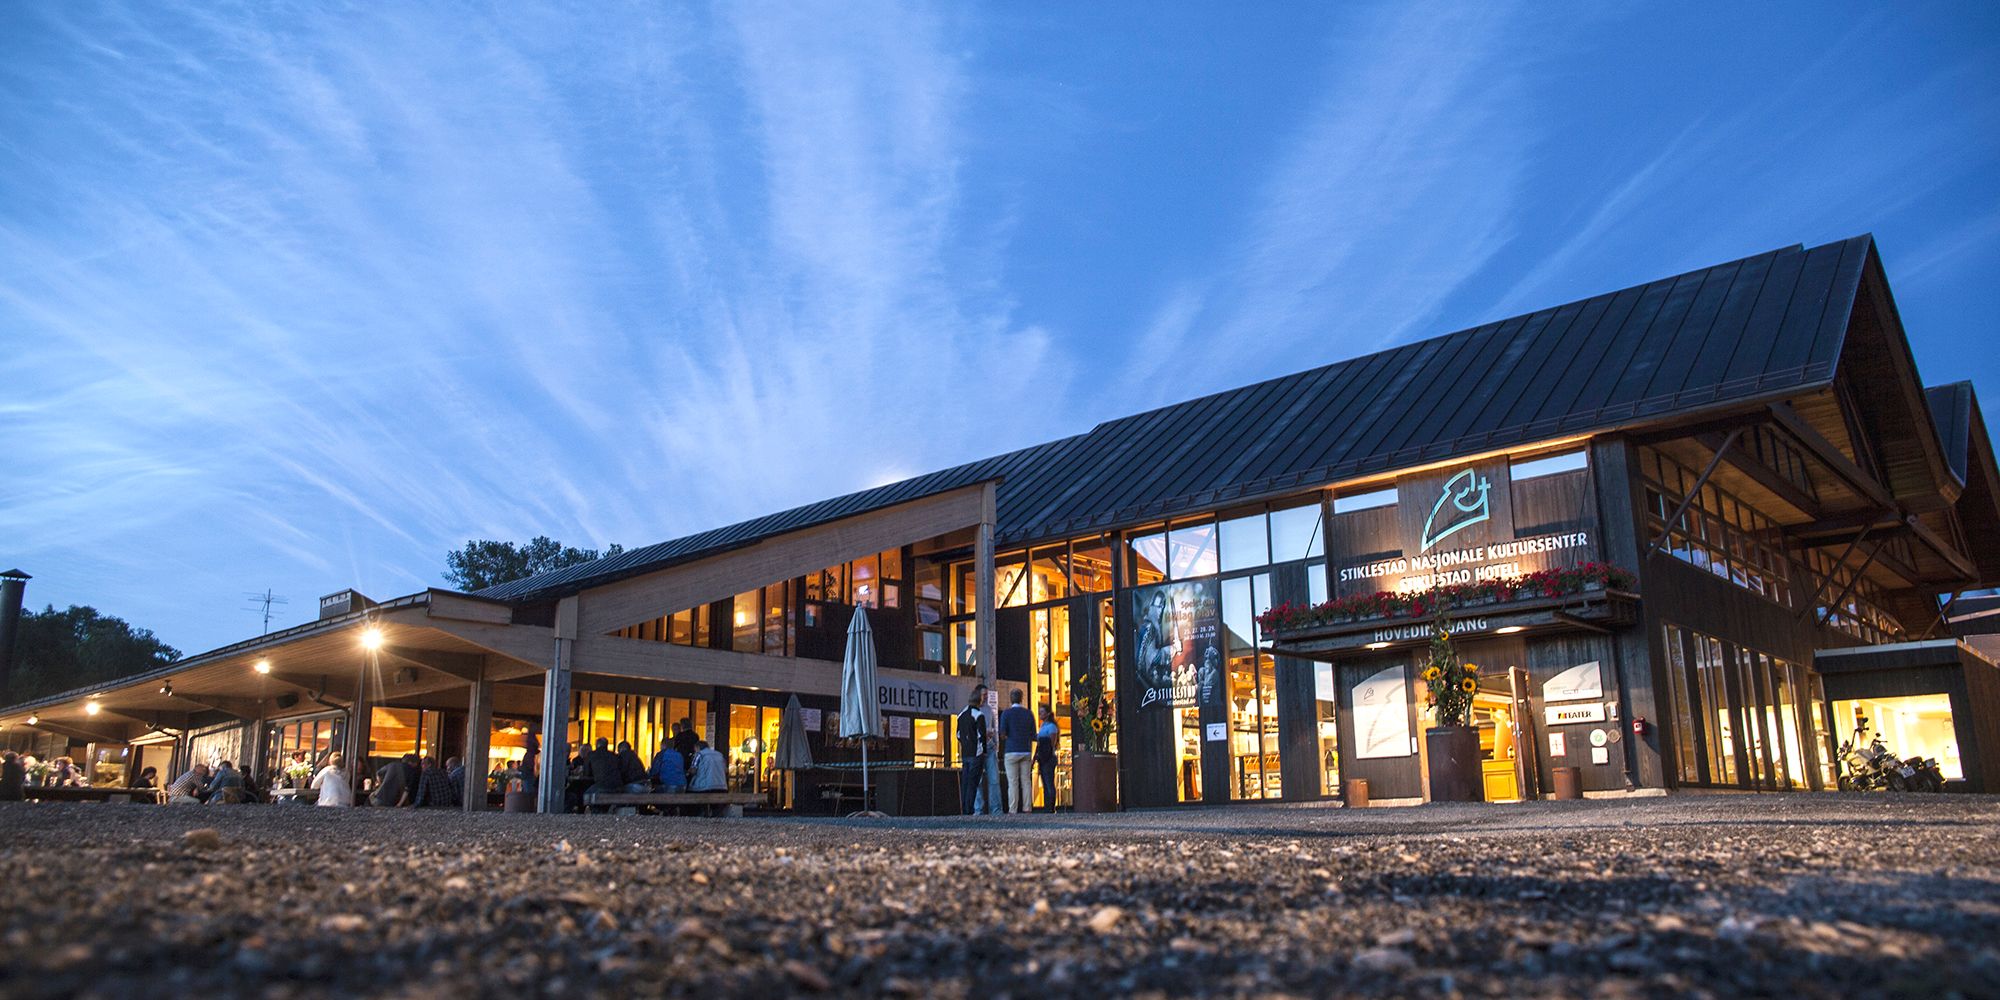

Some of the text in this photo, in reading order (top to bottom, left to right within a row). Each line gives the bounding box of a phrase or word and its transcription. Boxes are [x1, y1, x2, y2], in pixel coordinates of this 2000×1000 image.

[1340, 532, 1588, 582] STIKLESTAD NASJONALE KULTURSENTER
[1475, 562, 1519, 581] HOTELL
[1374, 618, 1488, 642] HOVEDINGANG
[878, 686, 949, 710] BILLETTER
[1157, 685, 1198, 700] STIKLESTAD
